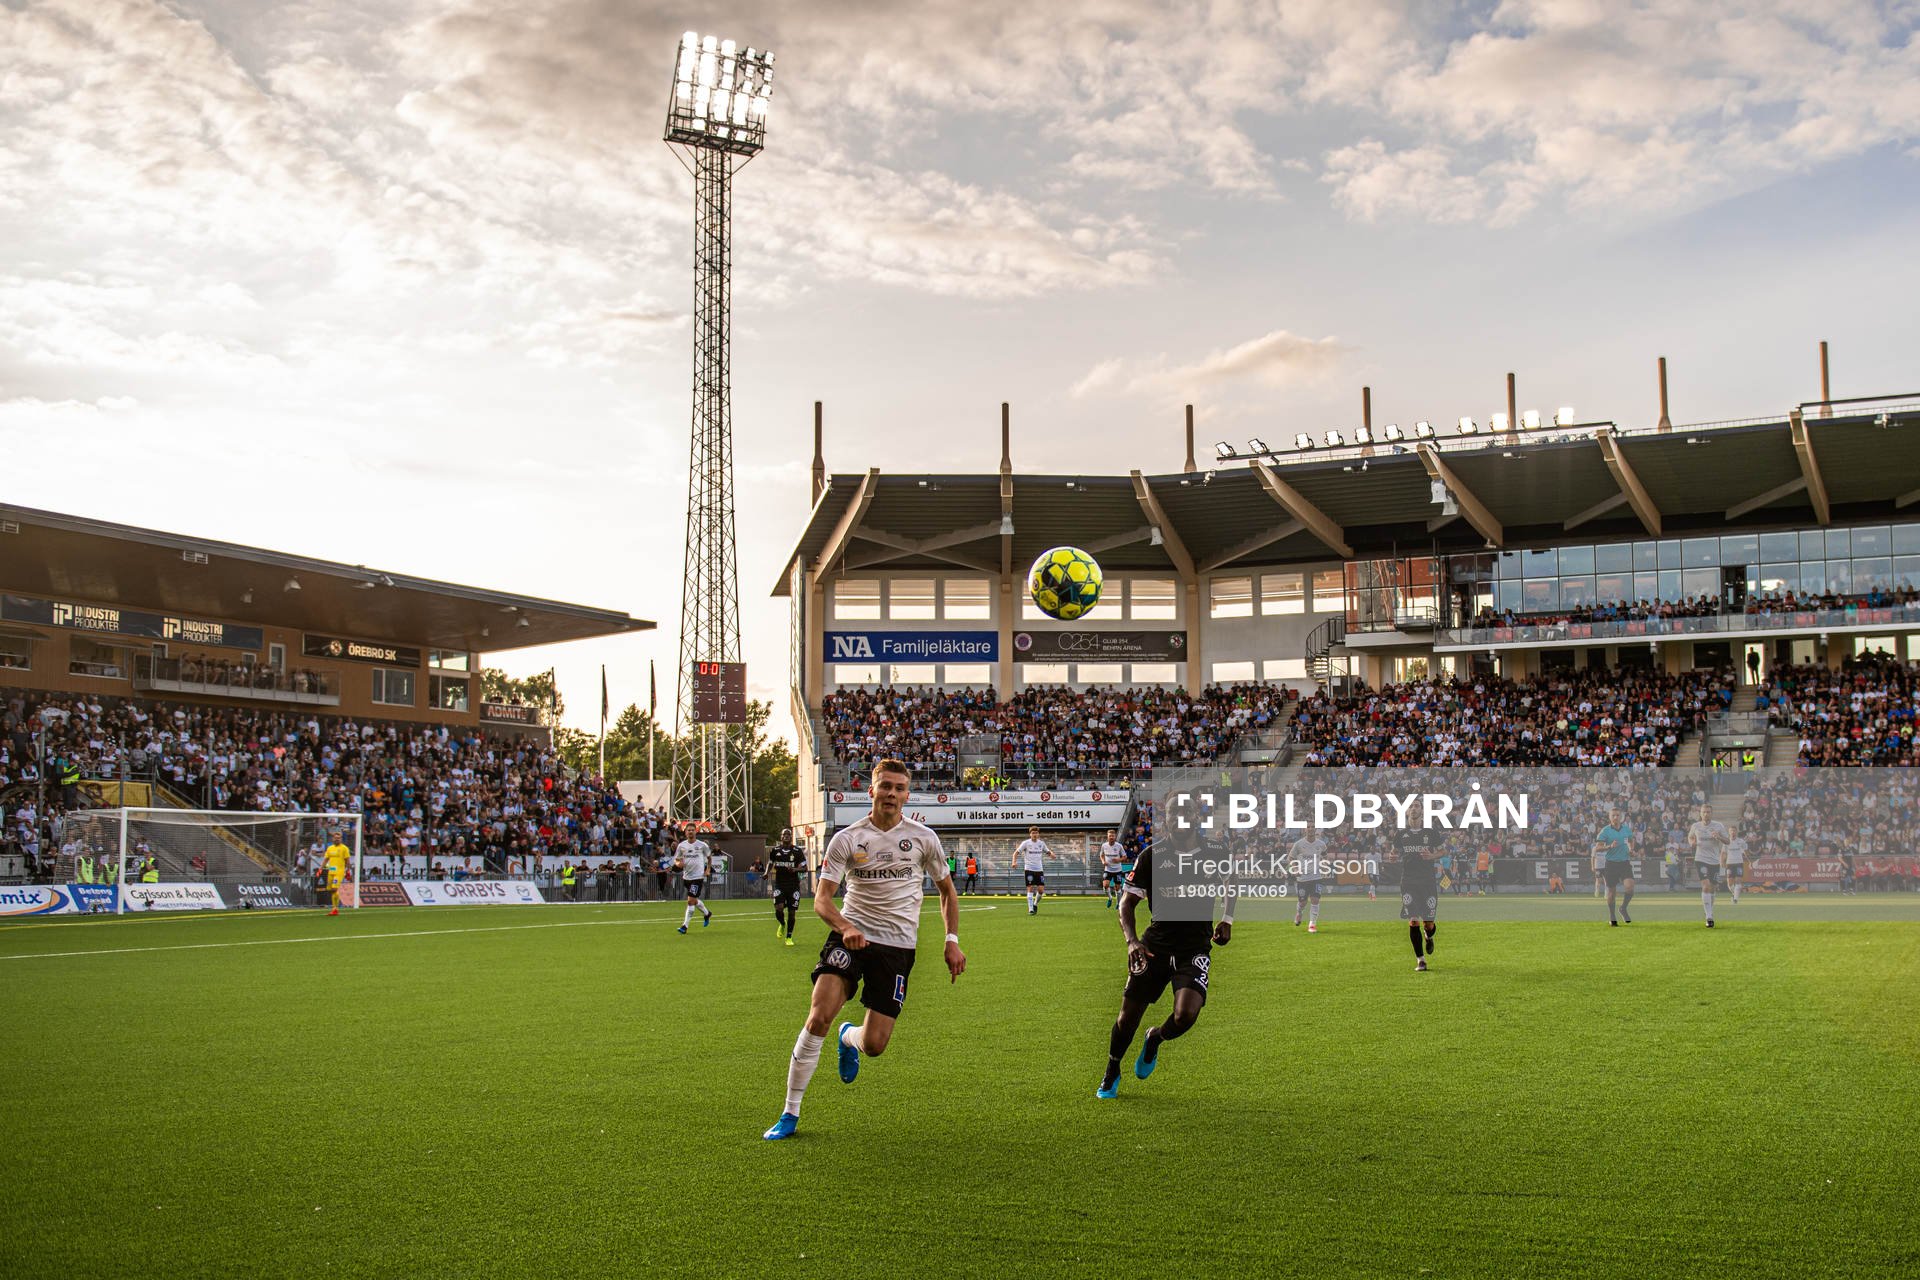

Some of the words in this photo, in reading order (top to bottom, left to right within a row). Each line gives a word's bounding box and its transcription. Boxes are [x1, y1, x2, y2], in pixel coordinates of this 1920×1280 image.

[75, 605, 119, 622] INDUSTRI
[74, 617, 119, 632] PRODUKTER
[183, 620, 223, 635] INDUSTRI
[183, 631, 223, 644] PRODUKTER
[348, 643, 384, 659] ÖREBRO
[384, 649, 397, 660] SK
[832, 636, 875, 657] NA
[883, 639, 991, 656] Familjeläktare
[957, 811, 967, 819] Vi
[969, 811, 998, 819] älskar
[1001, 811, 1024, 821] sport
[1036, 810, 1064, 819] sedan
[1068, 810, 1091, 819] 1914
[854, 868, 898, 879] BEHRN
[1816, 862, 1841, 873] 1177
[130, 888, 175, 899] Carlsson
[176, 890, 183, 898] &
[183, 887, 215, 900] Åqvist
[238, 884, 281, 895] ÖREBRO
[360, 885, 398, 894] WORK
[443, 883, 506, 898] ORRBYS
[0, 890, 43, 904] mix
